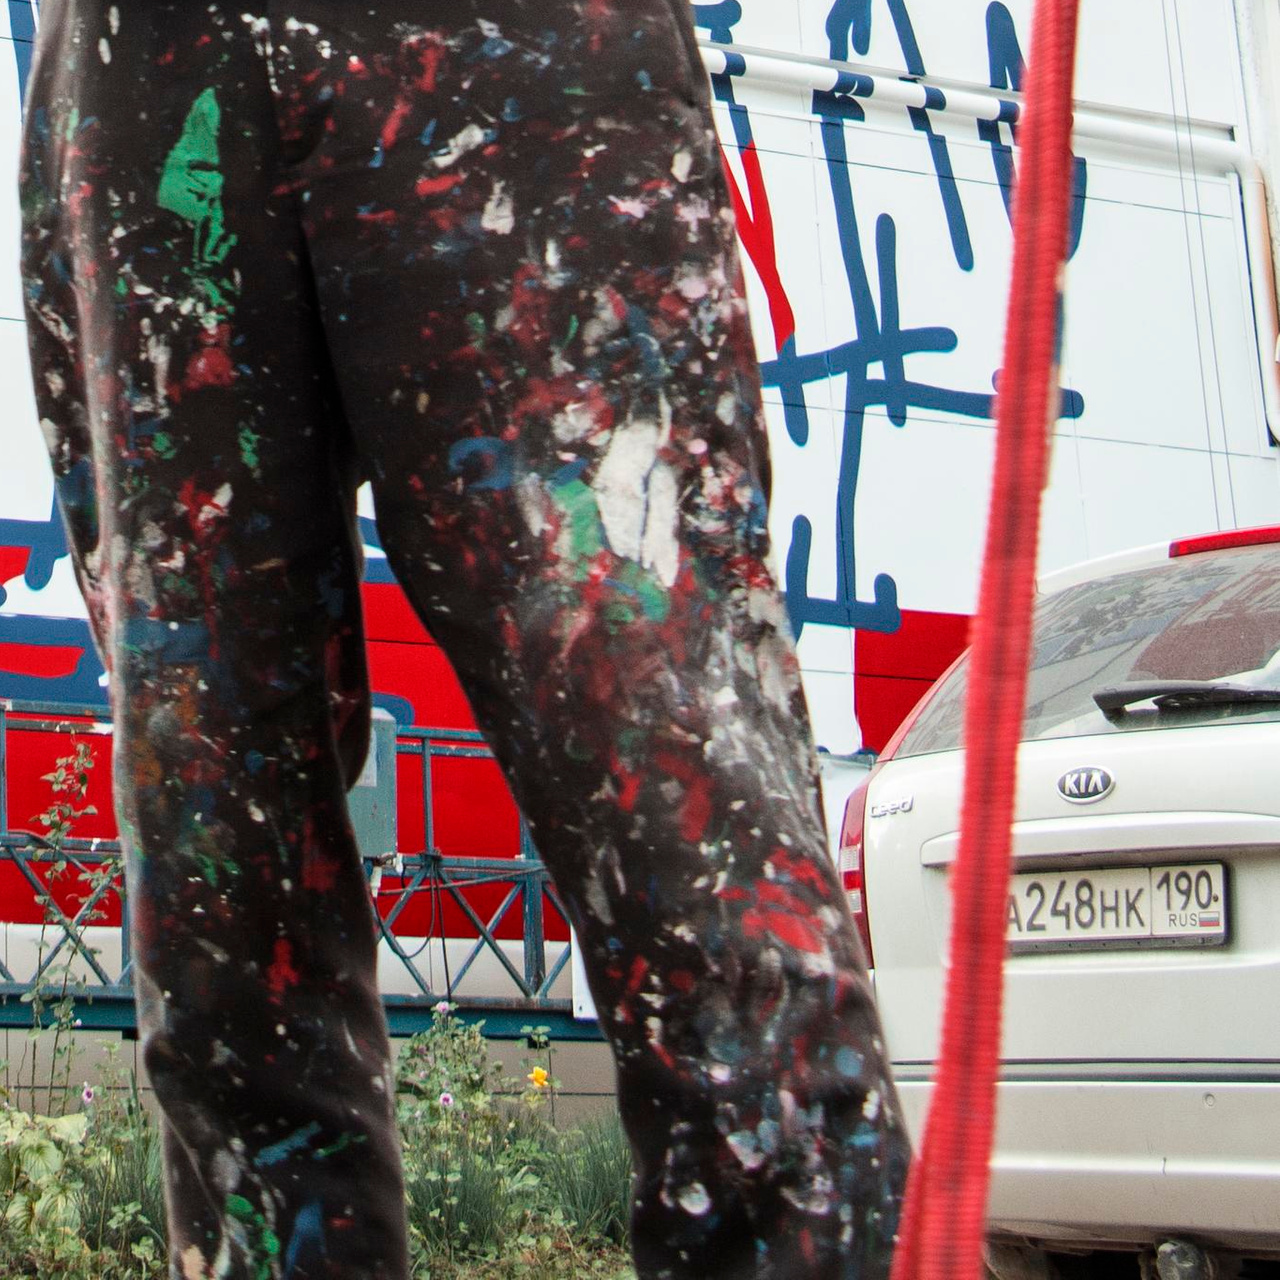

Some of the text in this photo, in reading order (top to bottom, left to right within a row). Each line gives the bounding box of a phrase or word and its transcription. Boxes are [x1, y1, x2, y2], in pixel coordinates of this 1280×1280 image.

[1064, 769, 1105, 795] KIA
[1156, 869, 1213, 912] 190
[1168, 912, 1198, 928] RUS
